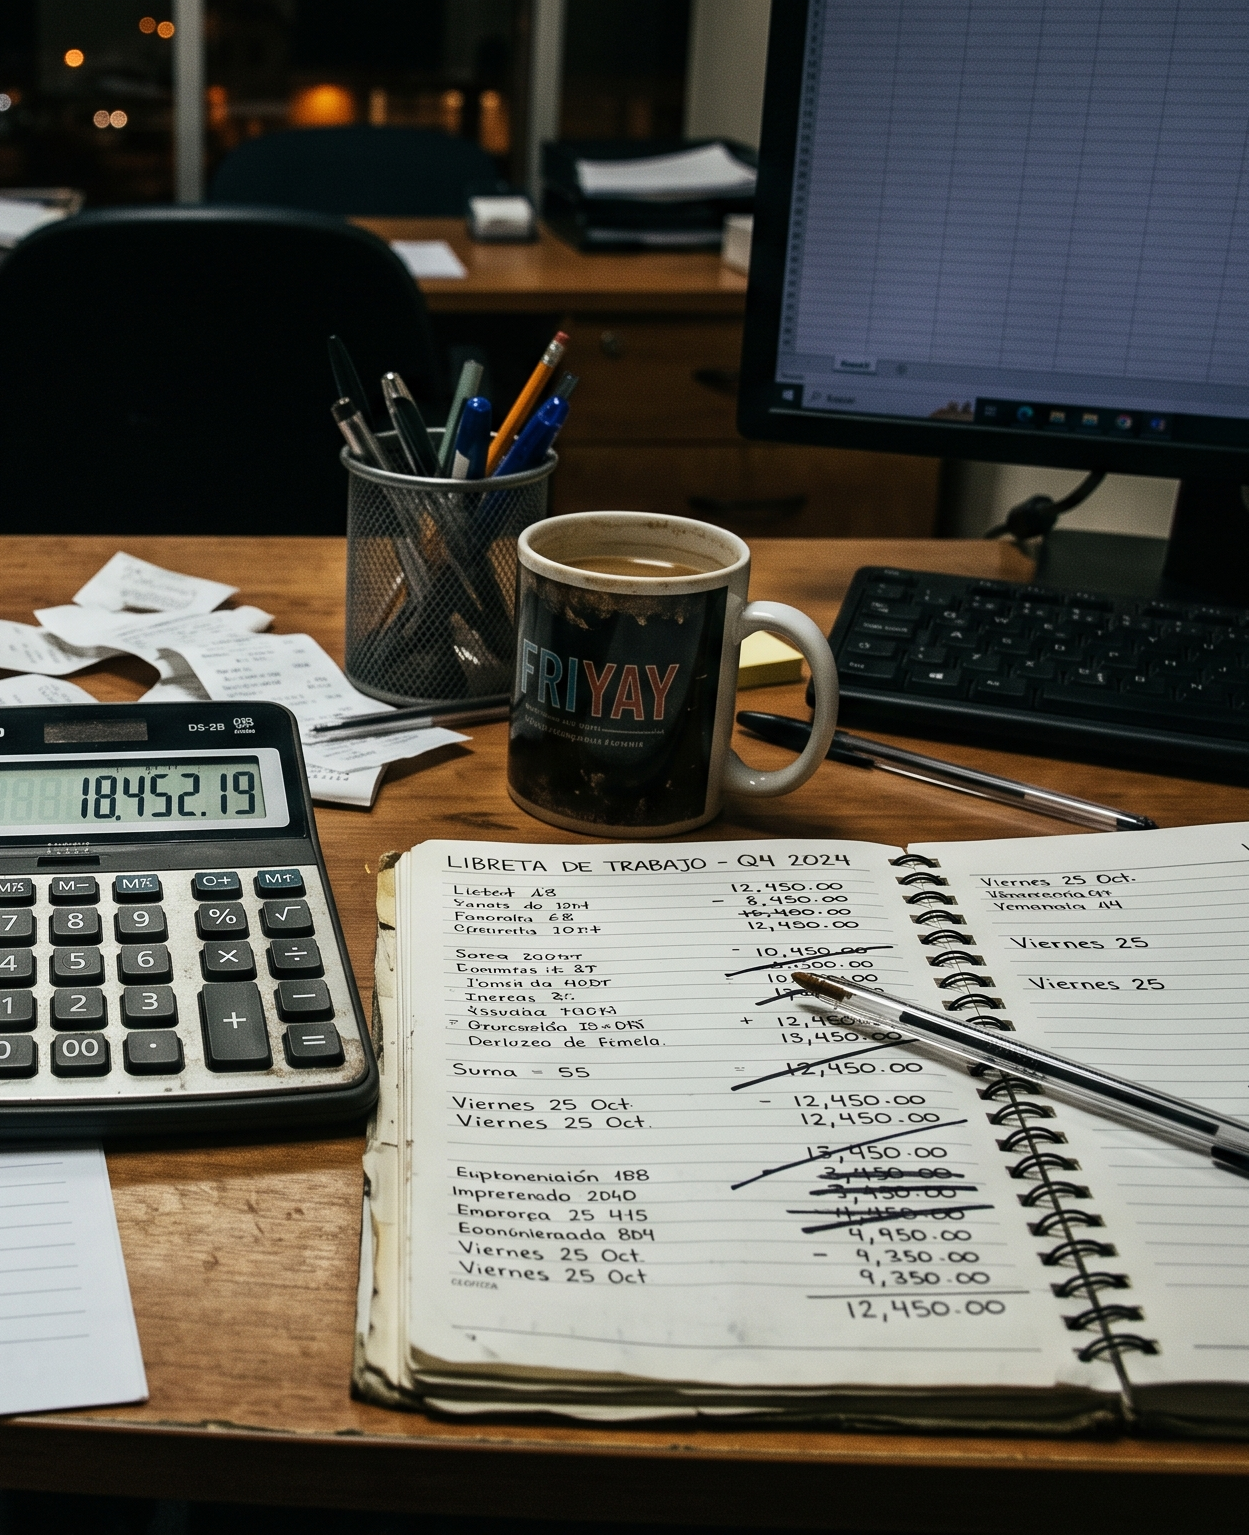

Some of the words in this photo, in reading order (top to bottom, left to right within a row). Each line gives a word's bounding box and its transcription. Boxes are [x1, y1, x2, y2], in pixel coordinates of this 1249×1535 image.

[521, 638, 680, 721] FRIYAY
[188, 723, 226, 732] DS-2B
[447, 855, 547, 872] LIBRETA
[562, 861, 593, 873] DE
[603, 857, 707, 873] TRABAJO
[737, 854, 775, 867] Q4
[788, 854, 851, 867] 2024
[980, 877, 1051, 887] Viernes
[1062, 875, 1087, 885] 25
[1, 914, 18, 931] 7
[67, 912, 84, 929] 8
[133, 910, 149, 927] 9
[209, 907, 236, 925] %
[1010, 936, 1105, 949] Viernes
[1115, 937, 1149, 949] 25
[0, 954, 18, 972] 4
[69, 952, 86, 970] 5
[137, 950, 154, 968] 6
[1028, 976, 1120, 991] Viernes
[1132, 978, 1165, 991] 25
[2, 997, 13, 1014] 1
[70, 994, 87, 1012] 2
[142, 992, 158, 1010] 3
[62, 1038, 99, 1057] 00
[564, 1036, 586, 1048] de
[452, 1096, 535, 1111] Viernes
[549, 1099, 577, 1111] 25
[794, 1095, 926, 1110] 12,450.00
[456, 1113, 548, 1129] Viernes
[564, 1117, 593, 1129] 25
[801, 1112, 940, 1128] 12,450.00
[569, 1209, 595, 1222] 25
[458, 1240, 545, 1261] Viernes
[560, 1247, 588, 1262] 25
[459, 1260, 550, 1282] Viernes
[565, 1268, 595, 1283] 25
[860, 1269, 990, 1287] 9,350.00
[847, 1300, 1006, 1322] 12,450.00
